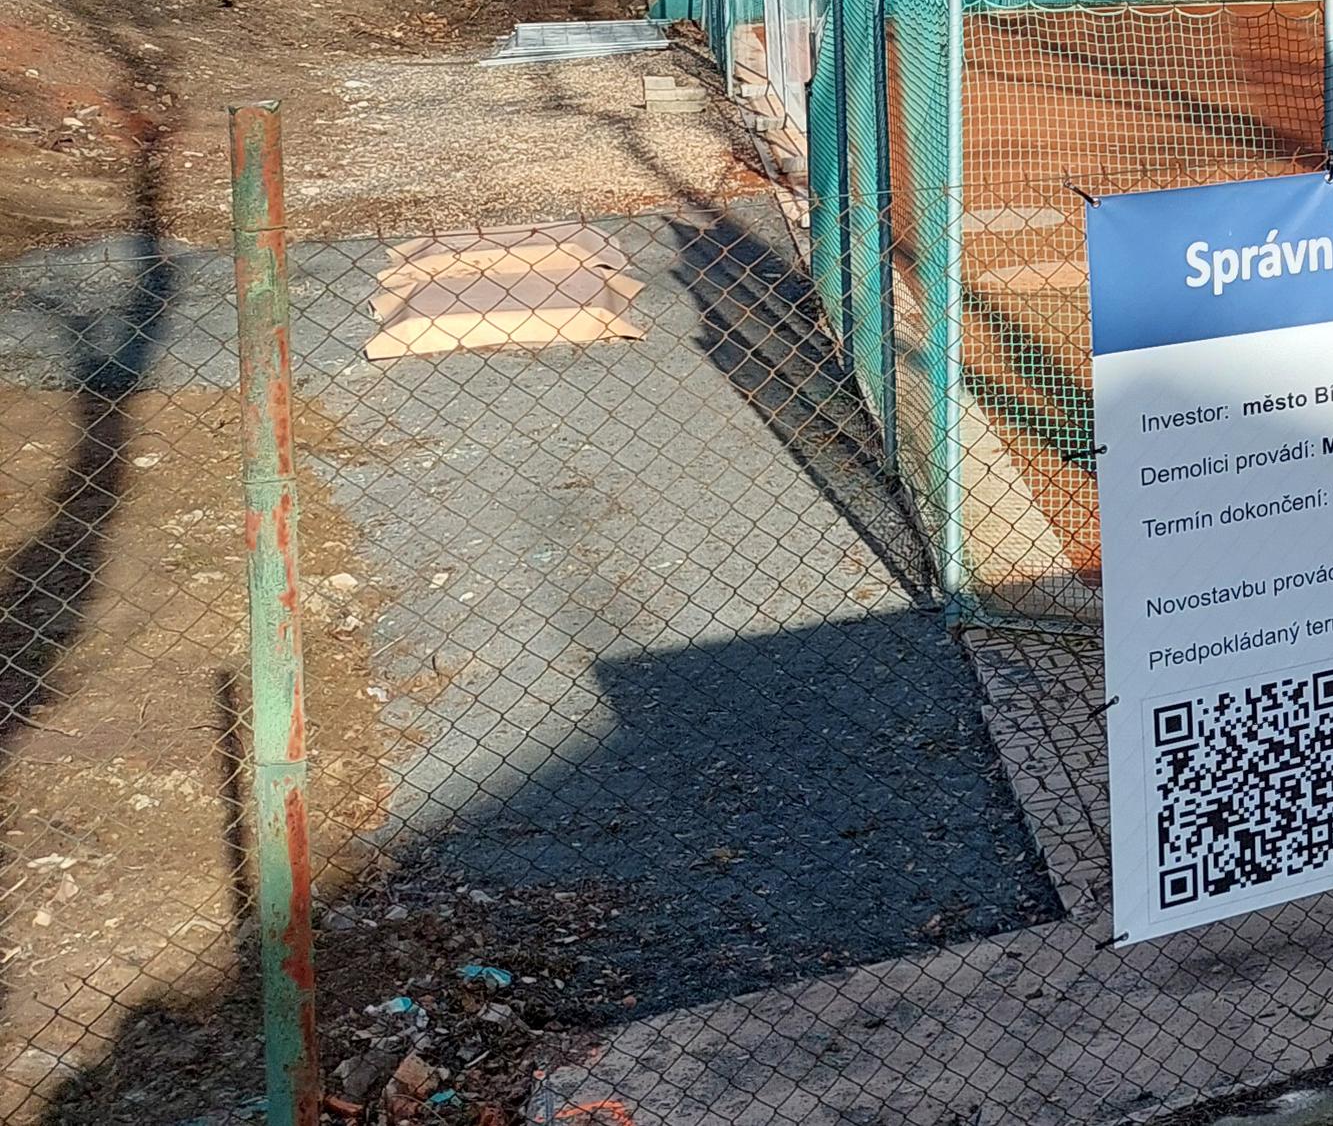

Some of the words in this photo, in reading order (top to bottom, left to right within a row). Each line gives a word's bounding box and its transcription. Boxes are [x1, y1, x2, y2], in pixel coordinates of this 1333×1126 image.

[1141, 405, 1229, 433] Investor:
[1242, 392, 1308, 417] město
[1140, 454, 1229, 486] Demolici
[1235, 440, 1315, 474] provádí:
[1142, 511, 1213, 538] Termín
[1219, 488, 1328, 525] dokončení:
[1146, 580, 1266, 618] Novostavbu
[1149, 621, 1300, 671] Předpokládaný
